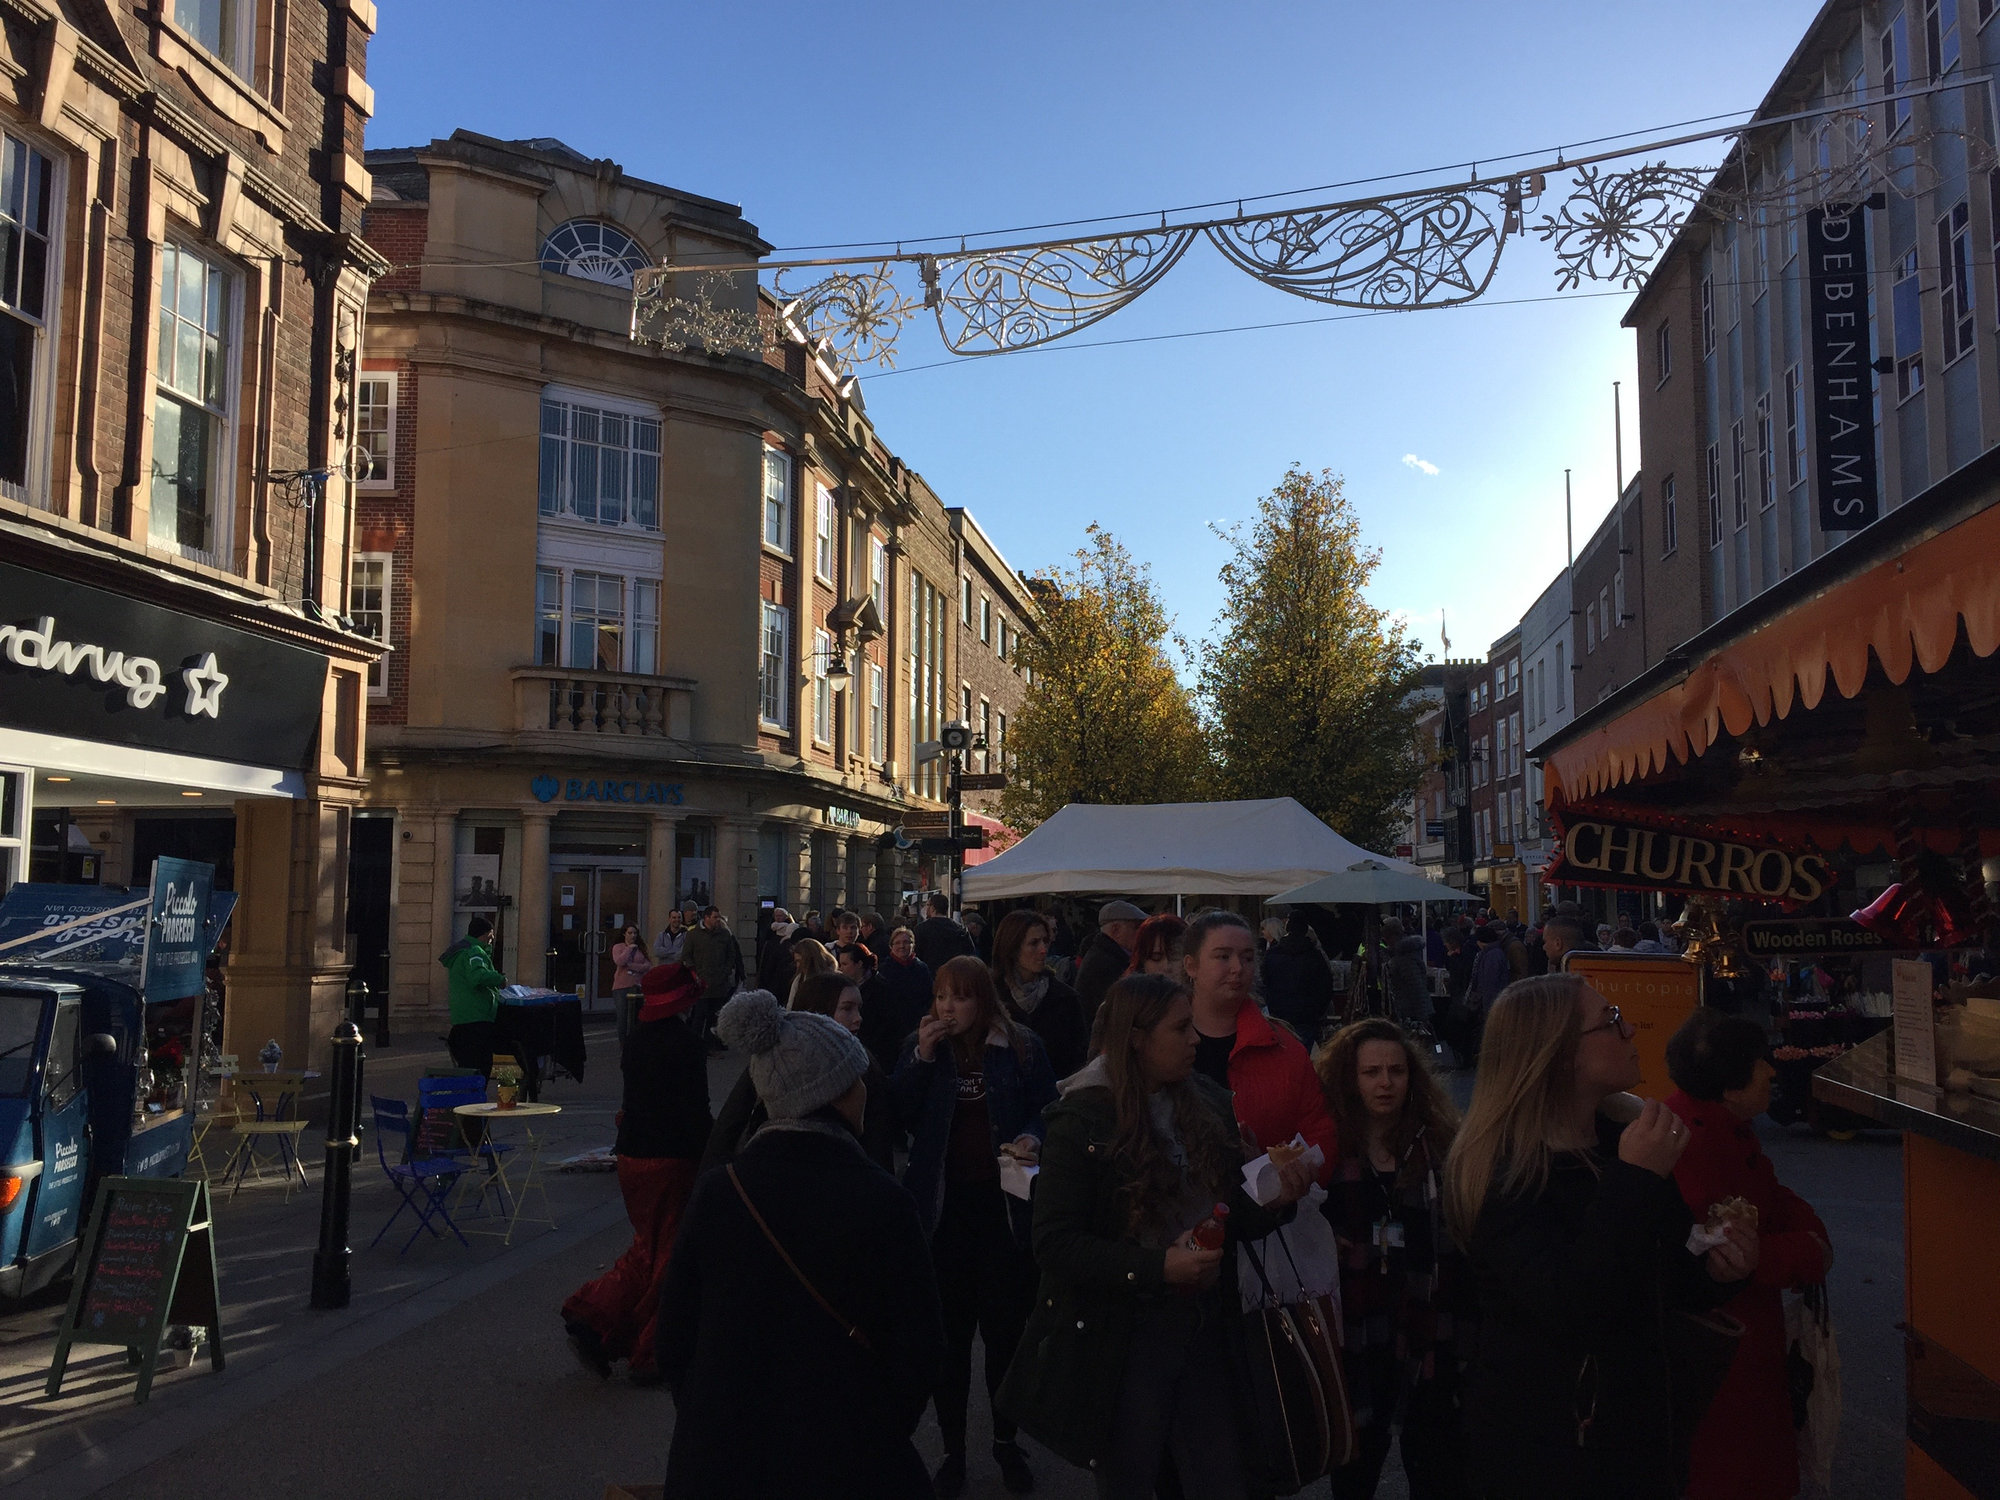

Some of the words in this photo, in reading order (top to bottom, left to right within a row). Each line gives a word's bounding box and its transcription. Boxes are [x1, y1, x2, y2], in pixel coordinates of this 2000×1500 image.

[1820, 202, 1865, 518] DEBENHAMS
[565, 778, 685, 805] BARCLAYS
[1565, 821, 1826, 902] CHURROS
[165, 881, 198, 915] Piccolo
[161, 917, 196, 944] PROSECCO
[1752, 930, 1826, 950] Wooden
[1831, 929, 1883, 947] Roses
[1594, 978, 1695, 997] hurtopia
